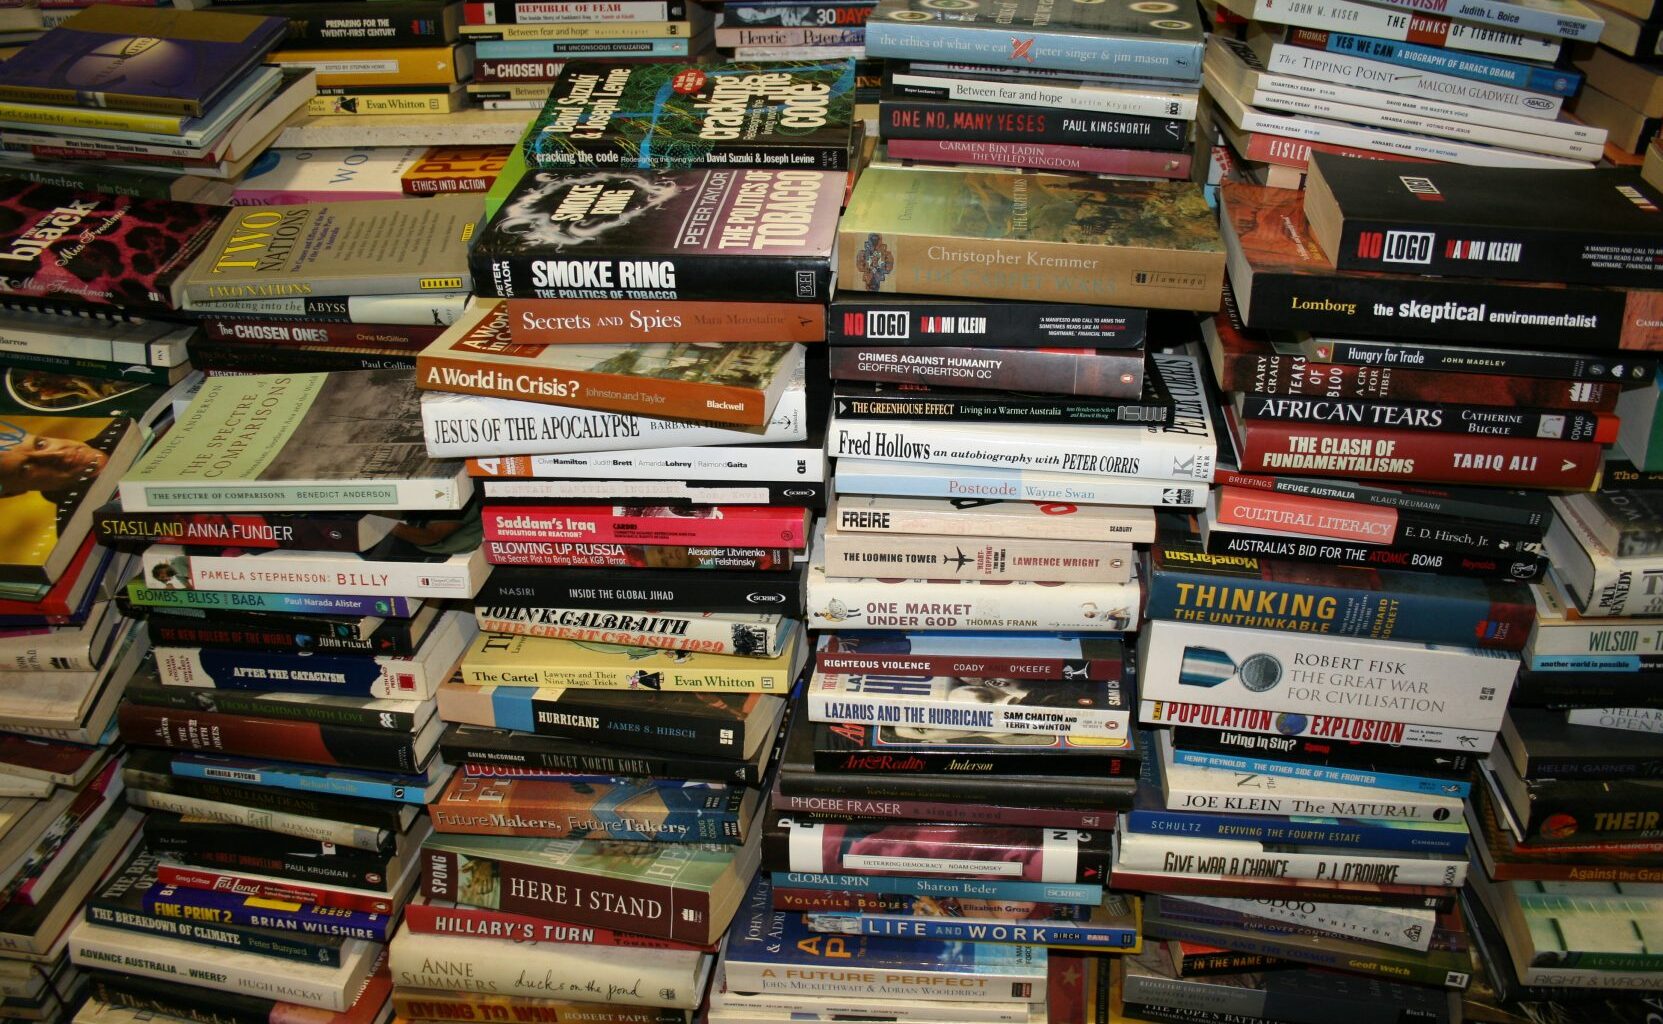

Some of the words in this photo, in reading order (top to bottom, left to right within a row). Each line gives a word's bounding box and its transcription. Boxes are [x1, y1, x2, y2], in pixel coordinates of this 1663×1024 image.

[326, 18, 361, 29] PREPARING
[362, 19, 375, 28] FOR
[377, 19, 390, 28] THE
[1459, 5, 1485, 18] Judith
[1487, 9, 1495, 19] L.
[1497, 11, 1520, 24] Boice
[321, 29, 365, 37] TWENTY-FIRST
[368, 28, 395, 37] CENTURY
[567, 43, 610, 51] UNCONSCIOUS
[612, 43, 651, 51] CIVILIZATION
[881, 36, 897, 45] the
[900, 37, 930, 47] ethics
[933, 37, 944, 47] of
[946, 39, 971, 50] what
[975, 43, 989, 51] we
[992, 43, 1007, 52] eat
[956, 85, 995, 96] Between
[999, 88, 1017, 97] fear
[1019, 89, 1037, 99] and
[1039, 90, 1062, 102] hope
[1271, 81, 1297, 89] QUARTERLY
[1417, 80, 1466, 97] MALCOLM
[1468, 87, 1519, 105] GLADWELL
[1063, 119, 1087, 132] PAUL
[1090, 120, 1151, 136] KINGSNORTH
[939, 140, 985, 153] CARMEN
[988, 144, 1007, 154] BIN
[1011, 144, 1045, 156] LADIN
[707, 154, 727, 163] David
[728, 153, 753, 163] Suzuki
[755, 154, 762, 163] &
[764, 154, 788, 165] Joseph
[789, 154, 815, 164] Levine
[412, 181, 437, 191] ETHICS
[439, 180, 458, 190] INTO
[460, 179, 485, 190] ACTION
[212, 211, 283, 274] TWO
[1445, 240, 1485, 261] NAOMI
[1487, 242, 1521, 262] KLEIN
[928, 246, 1020, 264] Christopher
[1027, 251, 1098, 269] Kremmer
[531, 261, 612, 288] SMOKE
[619, 261, 676, 288] RING
[308, 302, 346, 313] ABYSS
[1292, 297, 1357, 314] Lomborg
[1373, 302, 1393, 317] the
[1399, 300, 1486, 322] skeptical
[1489, 311, 1597, 328] environmentalist
[522, 311, 590, 330] Secrets
[597, 317, 623, 326] AND
[629, 310, 682, 332] Spies
[234, 325, 290, 340] CHOSEN
[294, 328, 327, 341] ONES
[858, 353, 898, 363] CRIMES
[900, 354, 945, 365] AGAINST
[948, 358, 1002, 368] HUMANITY
[1348, 347, 1381, 362] Hungry
[1384, 350, 1397, 362] for
[1399, 351, 1424, 363] Trade
[427, 367, 439, 383] A
[441, 368, 494, 388] World
[497, 374, 513, 390] in
[515, 376, 580, 397] Crisis?
[706, 400, 744, 411] Blackwell
[1258, 399, 1363, 422] AFRICAN
[1370, 405, 1444, 427] TEARS
[434, 418, 478, 444] JESUS
[482, 419, 500, 442] OF
[505, 418, 537, 441] THE
[541, 415, 640, 441] APOCALYPSE
[1062, 454, 1096, 471] PETER
[1099, 454, 1140, 474] CORRIS
[1453, 453, 1503, 471] TARIQ
[1509, 456, 1537, 471] ALI
[949, 480, 1017, 495] Postcode
[1025, 486, 1062, 498] Wayne
[1065, 488, 1095, 499] Swan
[102, 520, 183, 536] STASILAND
[188, 521, 228, 538] ANNA
[233, 525, 293, 541] FUNDER
[688, 548, 725, 556] Alexander
[727, 548, 765, 557] Litvinenko
[1013, 557, 1060, 566] LAWRENCE
[1063, 558, 1100, 568] WRIGHT
[201, 571, 245, 580] PAMELA
[337, 573, 388, 586] BILLY
[569, 588, 597, 599] INSIDE
[599, 590, 614, 599] THE
[616, 590, 647, 600] GLOBAL
[649, 590, 673, 600] JIHAD
[1177, 583, 1337, 619] THINKING
[867, 603, 897, 613] ONE
[906, 603, 972, 615] MARKET
[1589, 631, 1639, 651] WILSON
[824, 659, 878, 669] RIGHTEOUS
[882, 661, 931, 669] VIOLENCE
[1010, 665, 1050, 673] O'KEEFE
[1294, 653, 1362, 670] ROBERT
[1369, 661, 1406, 674] FISK
[608, 721, 640, 731] JAMES
[644, 724, 653, 733] S.
[657, 726, 696, 738] HIRSCH
[1167, 703, 1272, 730] POPULATION
[1311, 715, 1404, 743] EXPLOSION
[1182, 795, 1218, 807] JOE
[1222, 798, 1282, 811] KLEIN
[1293, 800, 1324, 813] The
[1332, 803, 1419, 818] NATURAL
[1594, 811, 1659, 831] THEIR
[1151, 820, 1201, 832] SCHULTZ
[1218, 825, 1262, 836] REVIVING
[1267, 828, 1283, 837] THE
[1288, 829, 1324, 840] FOURTH
[1329, 833, 1360, 843] ESTATE
[284, 863, 305, 872] PAUL
[308, 865, 348, 878] KRUGMAN
[1569, 867, 1616, 880] Against
[1619, 872, 1635, 880] the
[917, 881, 959, 892] Sharon
[964, 884, 997, 894] Beder
[510, 878, 567, 904] HERE
[575, 888, 581, 906] I
[589, 891, 662, 919] STAND
[250, 915, 297, 930] BRIAN
[303, 921, 374, 939] WILSHIRE
[436, 916, 533, 937] HILLARY'S
[544, 925, 594, 943] TURN
[869, 920, 927, 935] LIFE
[935, 926, 962, 935] AND
[968, 925, 1046, 941] WORK
[80, 951, 122, 963] ADVANCE
[125, 956, 176, 973] AUSTRALIA
[190, 968, 227, 983] WHERE?
[422, 959, 472, 977] ANNE
[1349, 960, 1376, 969] Geoff
[1380, 965, 1411, 975] Welch
[239, 978, 273, 991] HUGH
[277, 985, 322, 1002] MACKAY
[403, 972, 497, 991] SUMMERS
[886, 975, 988, 987] PERFECT
